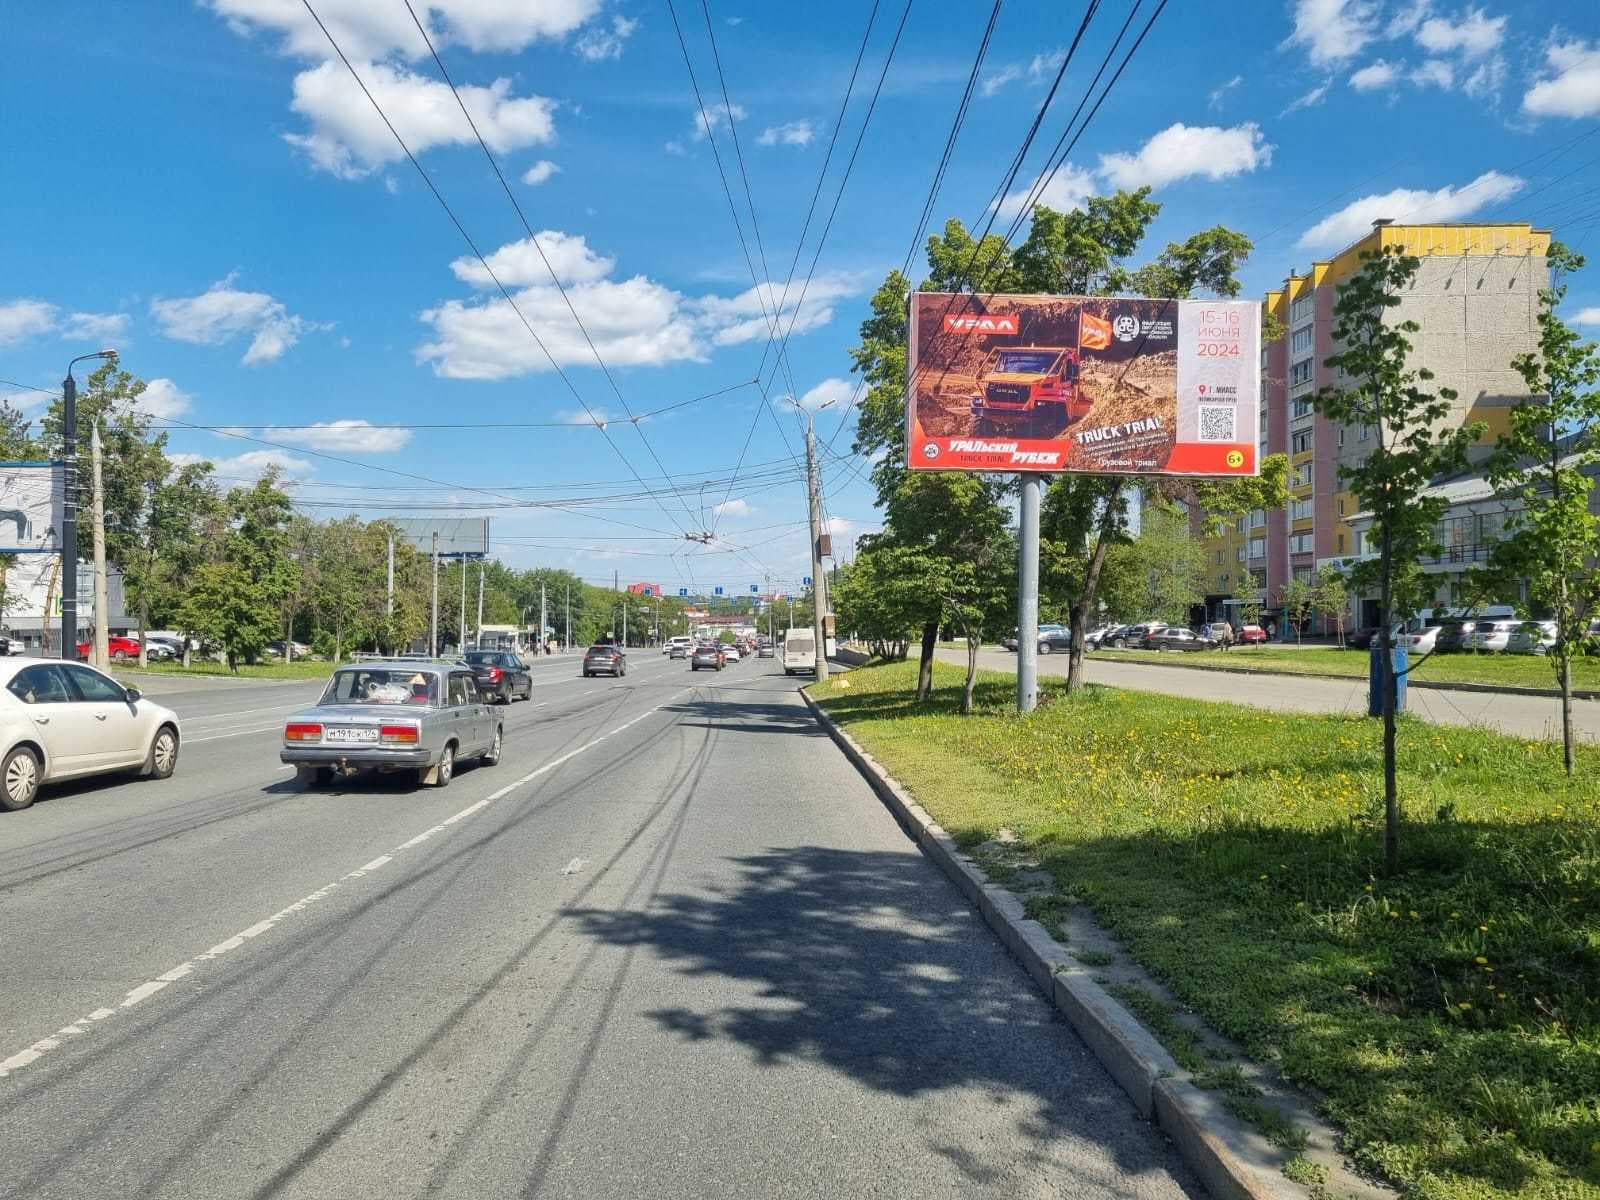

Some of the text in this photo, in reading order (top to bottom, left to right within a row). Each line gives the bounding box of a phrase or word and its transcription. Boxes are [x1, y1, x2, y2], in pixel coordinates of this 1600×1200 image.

[1200, 311, 1240, 324] 15-16
[1198, 328, 1240, 337] ИЮНЯ
[1198, 343, 1241, 357] 2024
[1076, 425, 1120, 444] TRUCK
[1124, 416, 1164, 435] TRIAL
[1228, 454, 1241, 464] 6+
